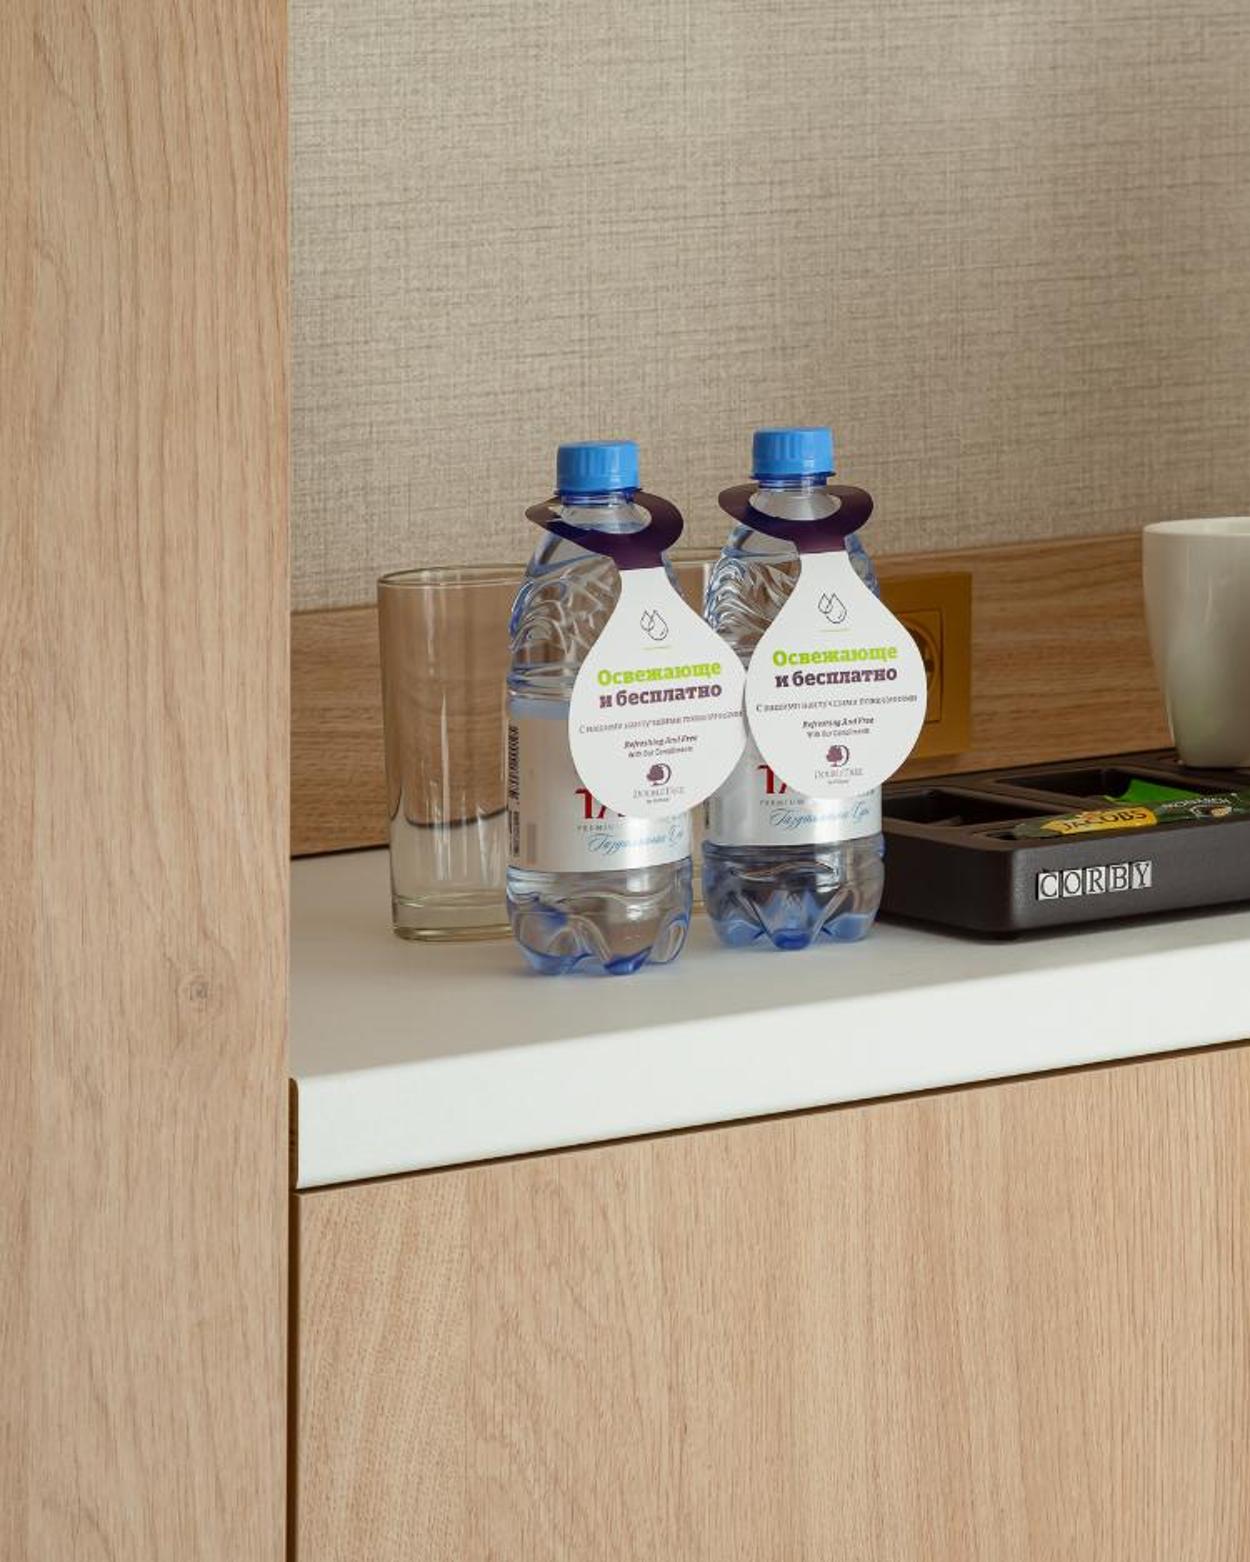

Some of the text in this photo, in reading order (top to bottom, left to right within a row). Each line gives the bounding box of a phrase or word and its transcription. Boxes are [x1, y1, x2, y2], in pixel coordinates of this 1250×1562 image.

[772, 646, 897, 668] Освежающе
[597, 662, 721, 686] Освежающе
[775, 667, 898, 688] и бесплатно
[599, 684, 722, 708] и бесплатно
[1038, 861, 1152, 899] CORBY
